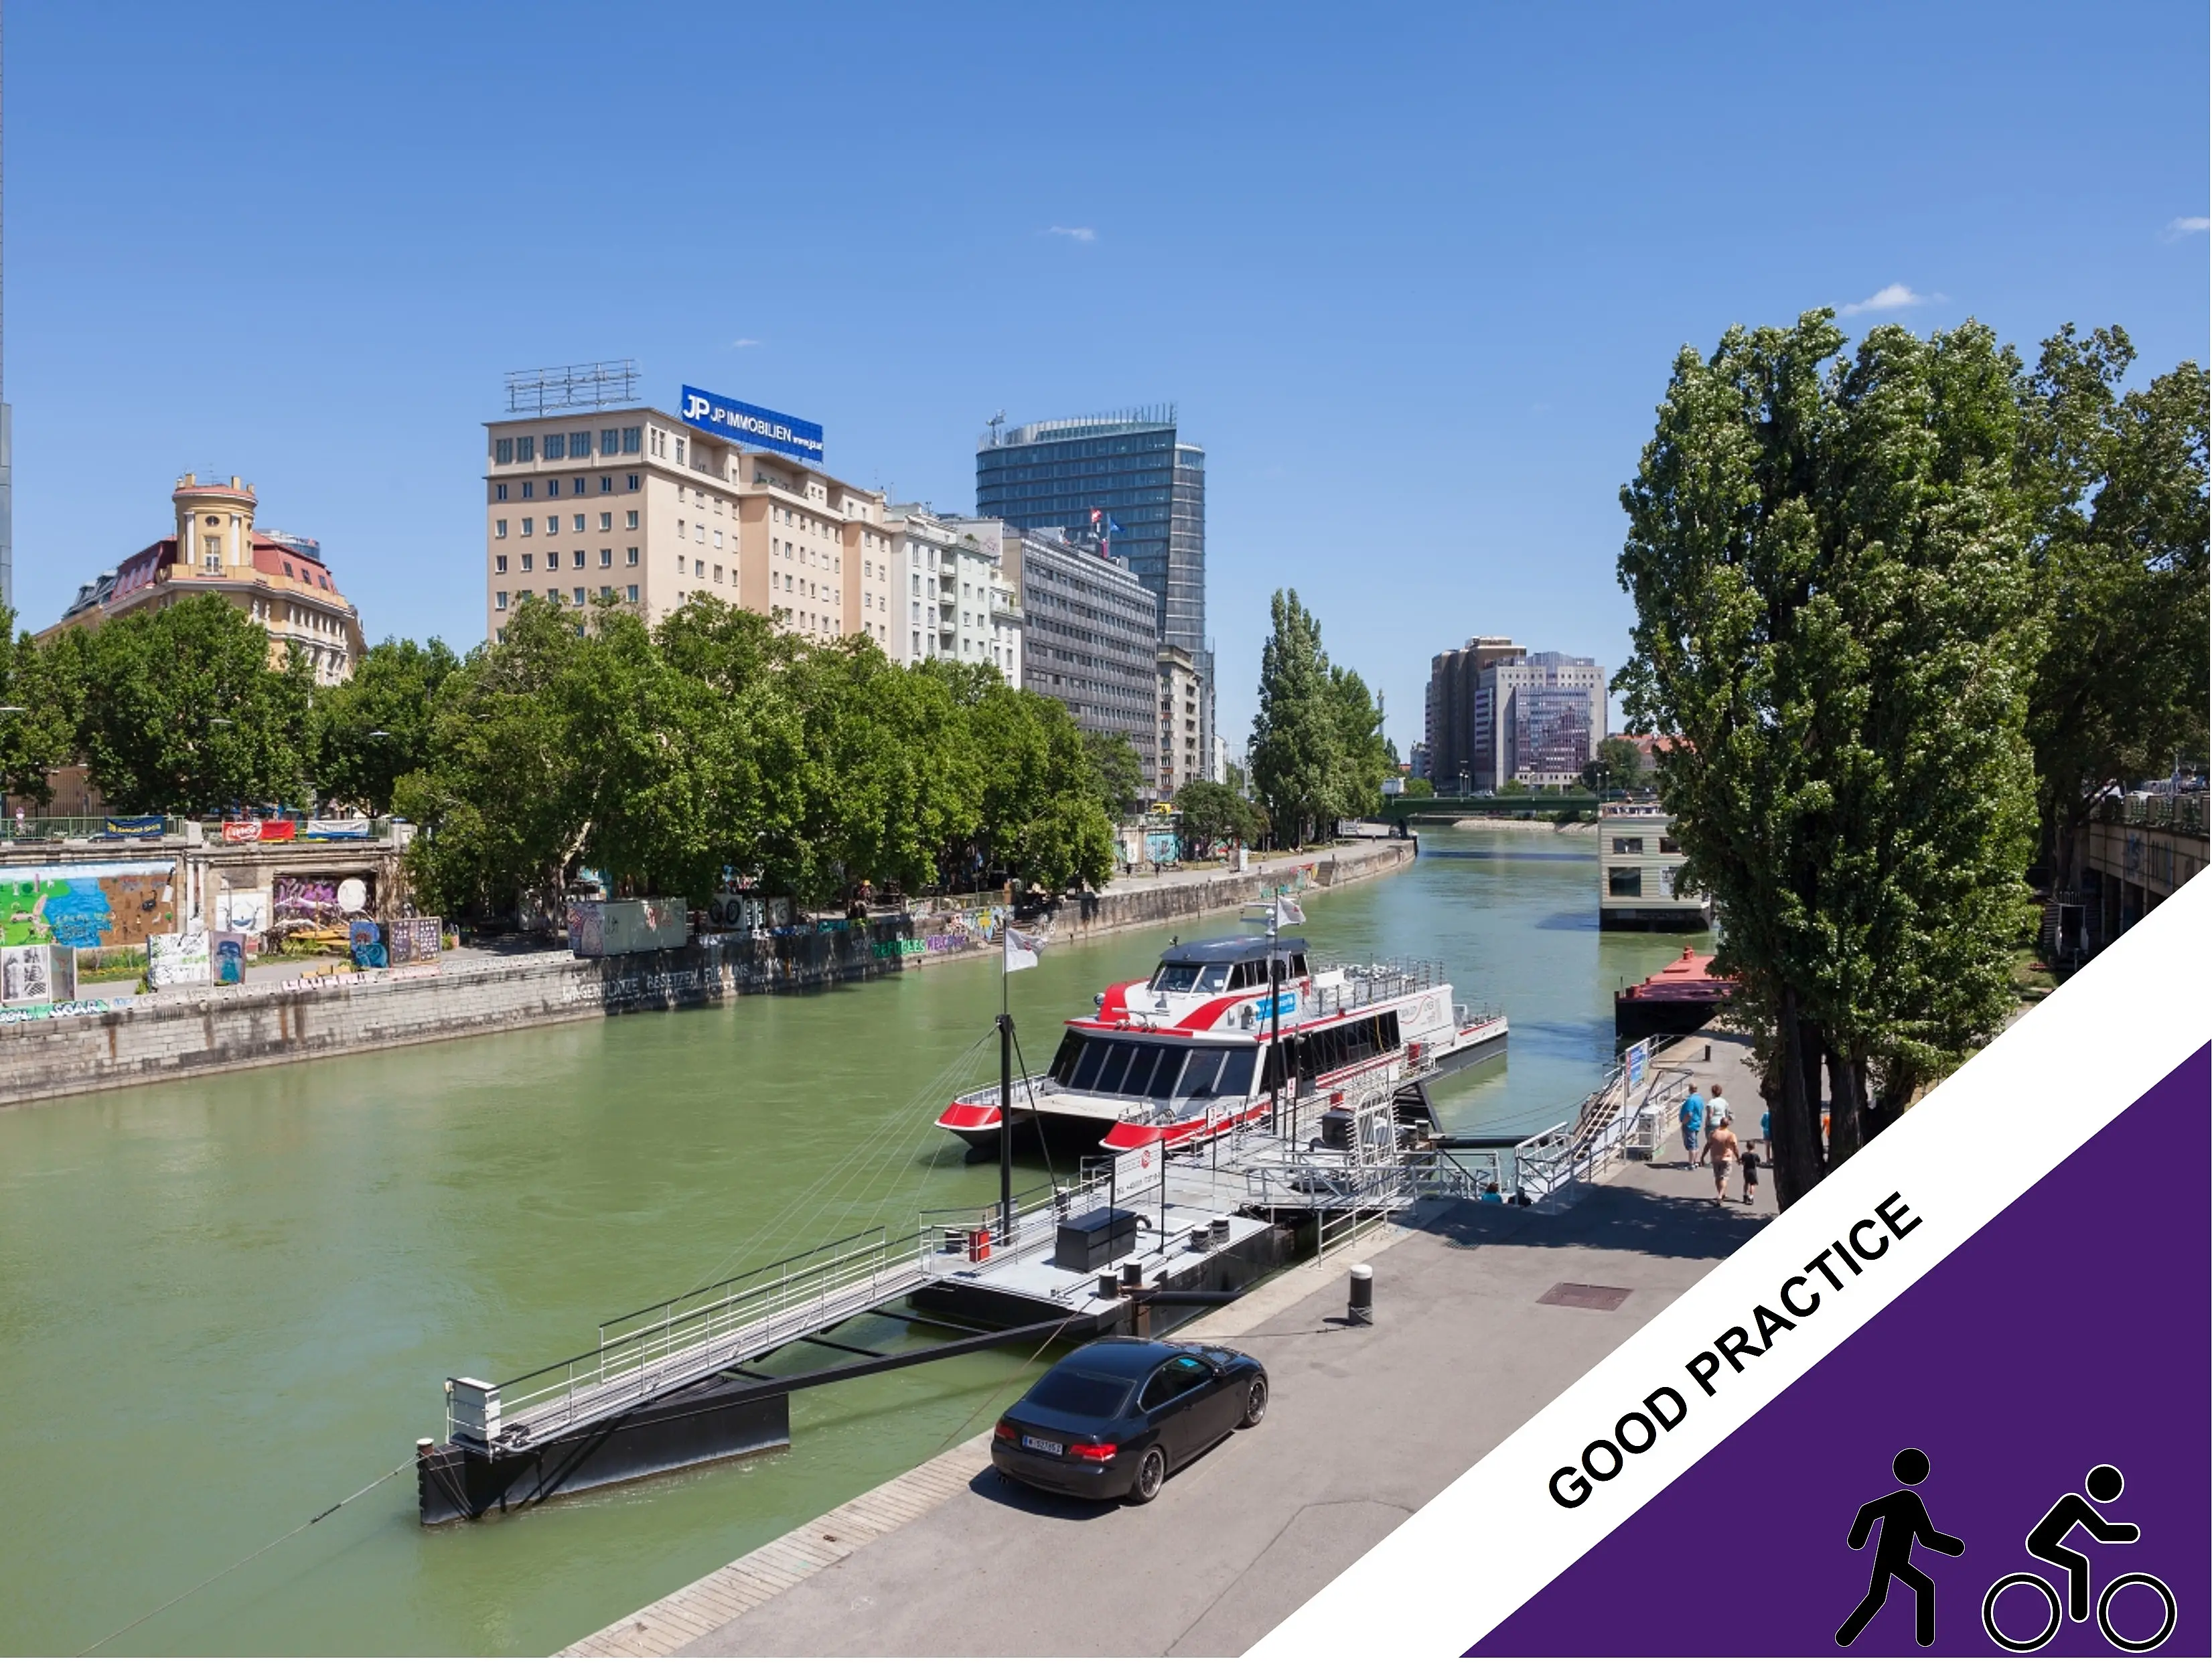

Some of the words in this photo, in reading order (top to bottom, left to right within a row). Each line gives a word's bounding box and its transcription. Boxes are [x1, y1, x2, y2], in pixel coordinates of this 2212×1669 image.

[683, 394, 709, 421] JP
[710, 407, 725, 423] JP
[727, 412, 791, 442] IMMOBILIEN
